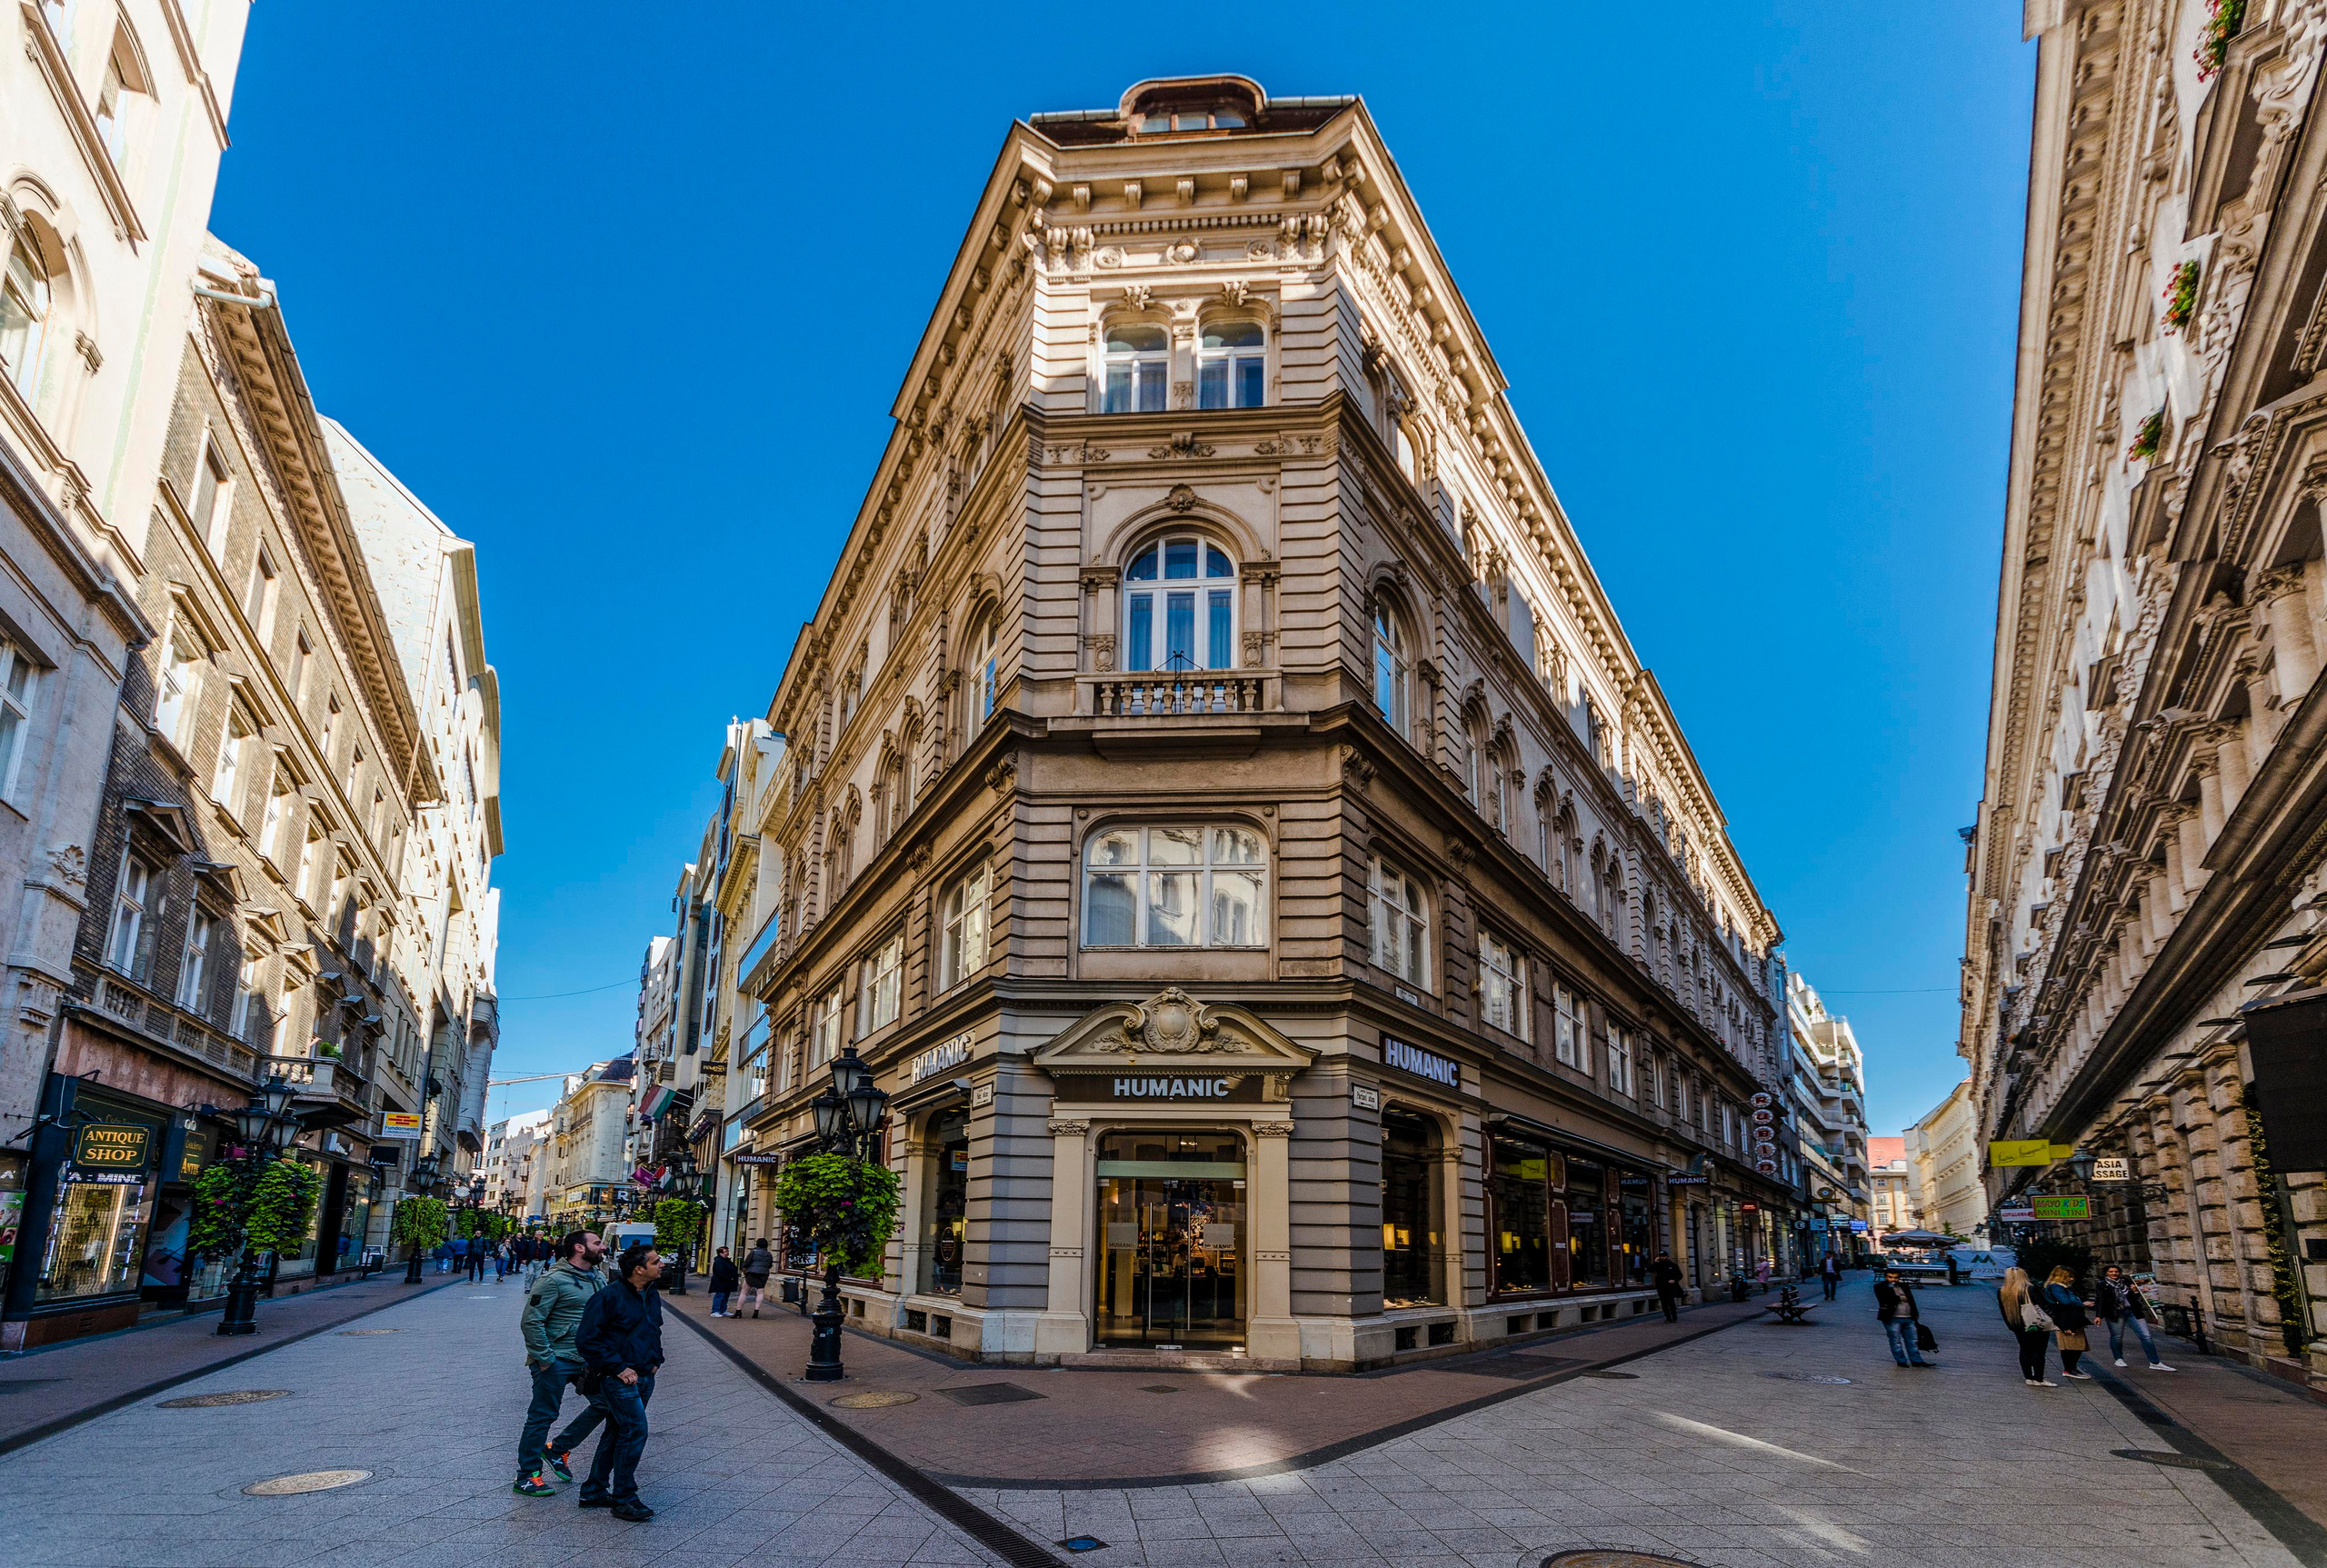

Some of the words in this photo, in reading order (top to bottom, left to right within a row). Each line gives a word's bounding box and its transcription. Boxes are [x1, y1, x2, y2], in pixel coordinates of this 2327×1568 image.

[913, 1035, 970, 1083] HUMANIC
[1384, 1038, 1458, 1087] HUMANIC
[1114, 1078, 1229, 1097] HUMANIC
[85, 1130, 145, 1144] ANTIQUE
[85, 1148, 137, 1161] SHOP
[737, 1155, 776, 1164] HUMANIC
[2097, 1160, 2122, 1169] ASIA
[2092, 1170, 2128, 1178] SSAGE
[1669, 1176, 1708, 1184] HUMANIC
[2062, 1199, 2085, 1208] KIDS
